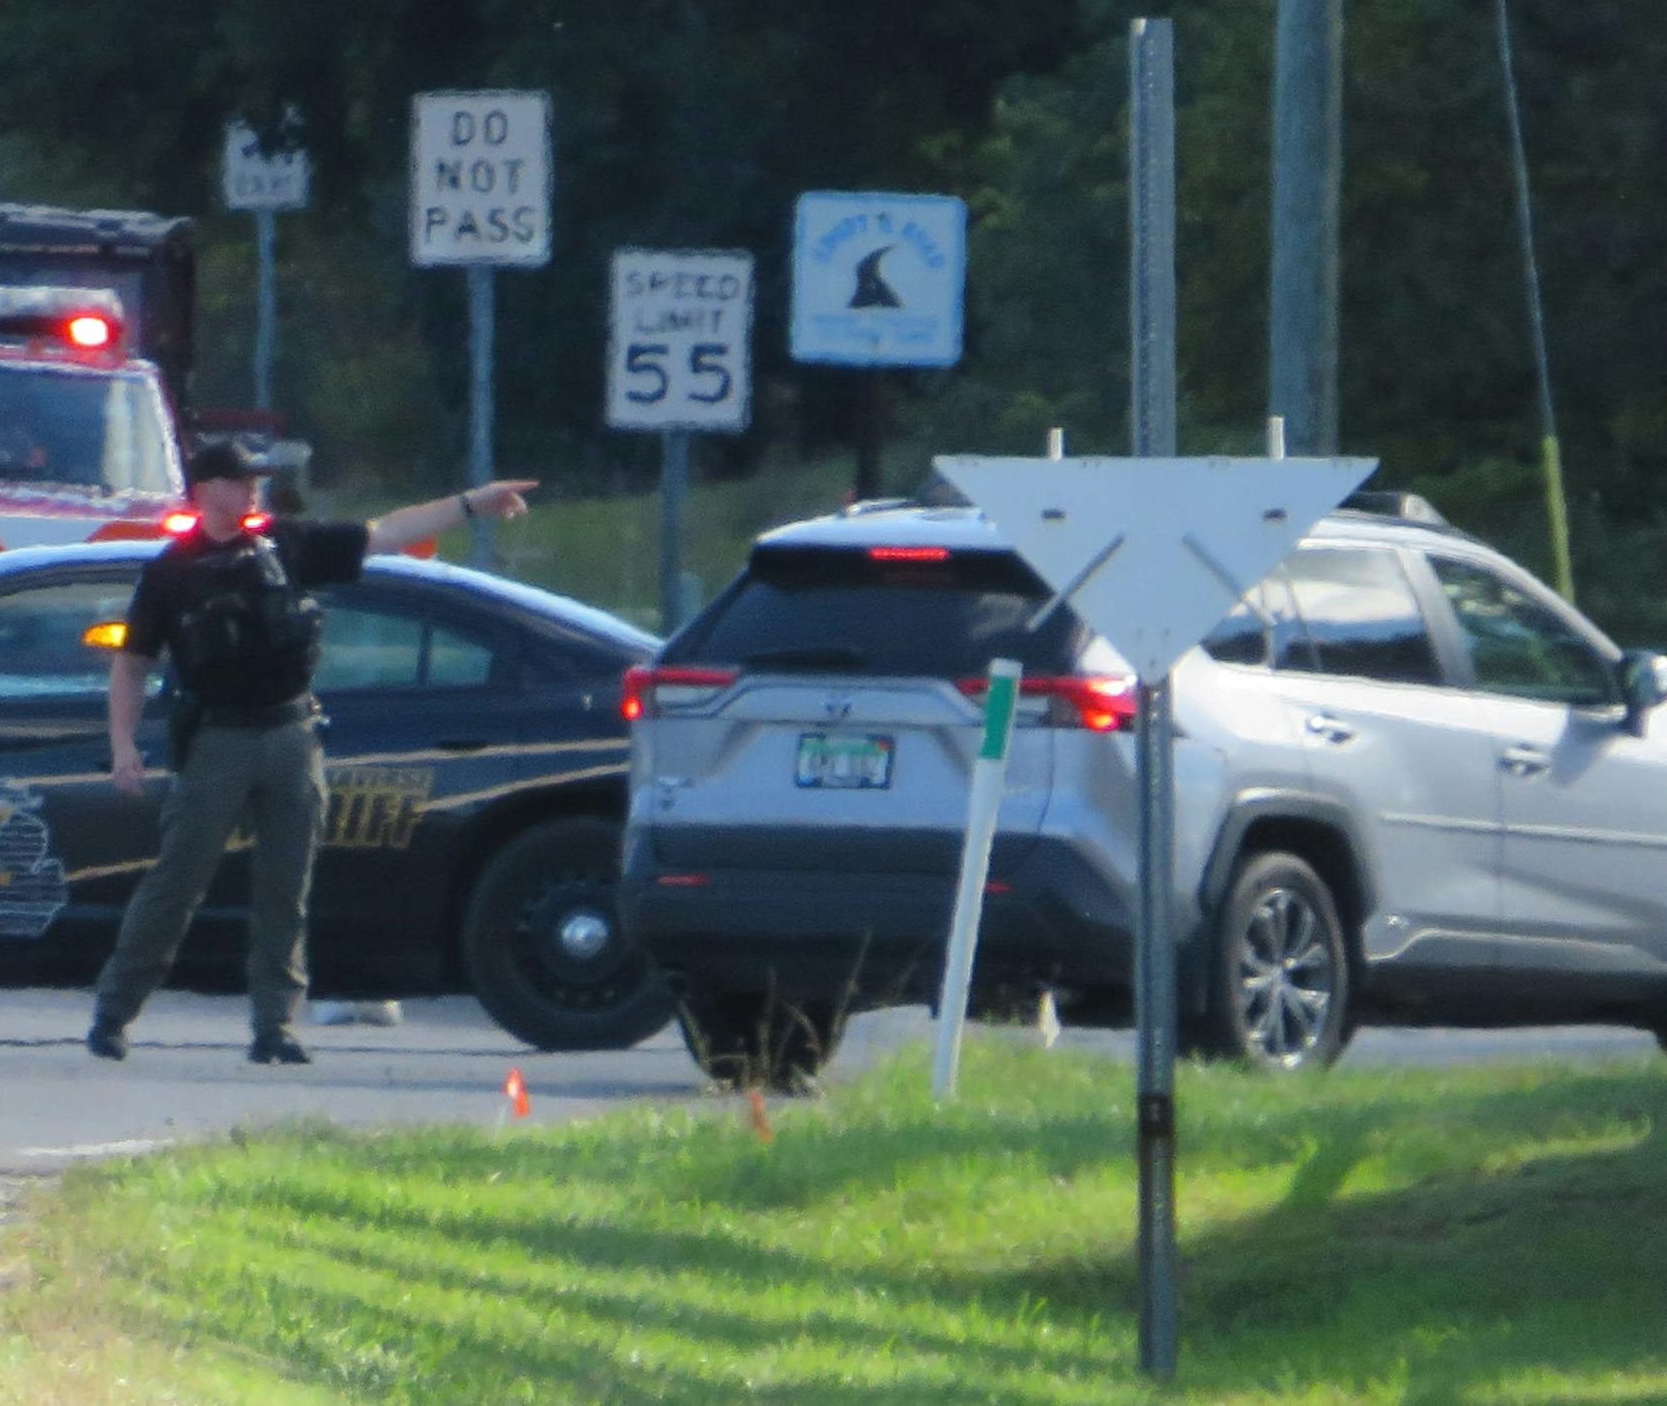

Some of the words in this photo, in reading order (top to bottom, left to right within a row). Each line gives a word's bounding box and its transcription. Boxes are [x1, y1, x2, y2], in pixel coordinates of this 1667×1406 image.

[451, 109, 509, 146] DO
[435, 156, 525, 194] NOT
[425, 204, 537, 244] PASS
[626, 267, 741, 300] SPEED
[633, 309, 723, 334] LIMIT
[625, 344, 733, 404] 55
